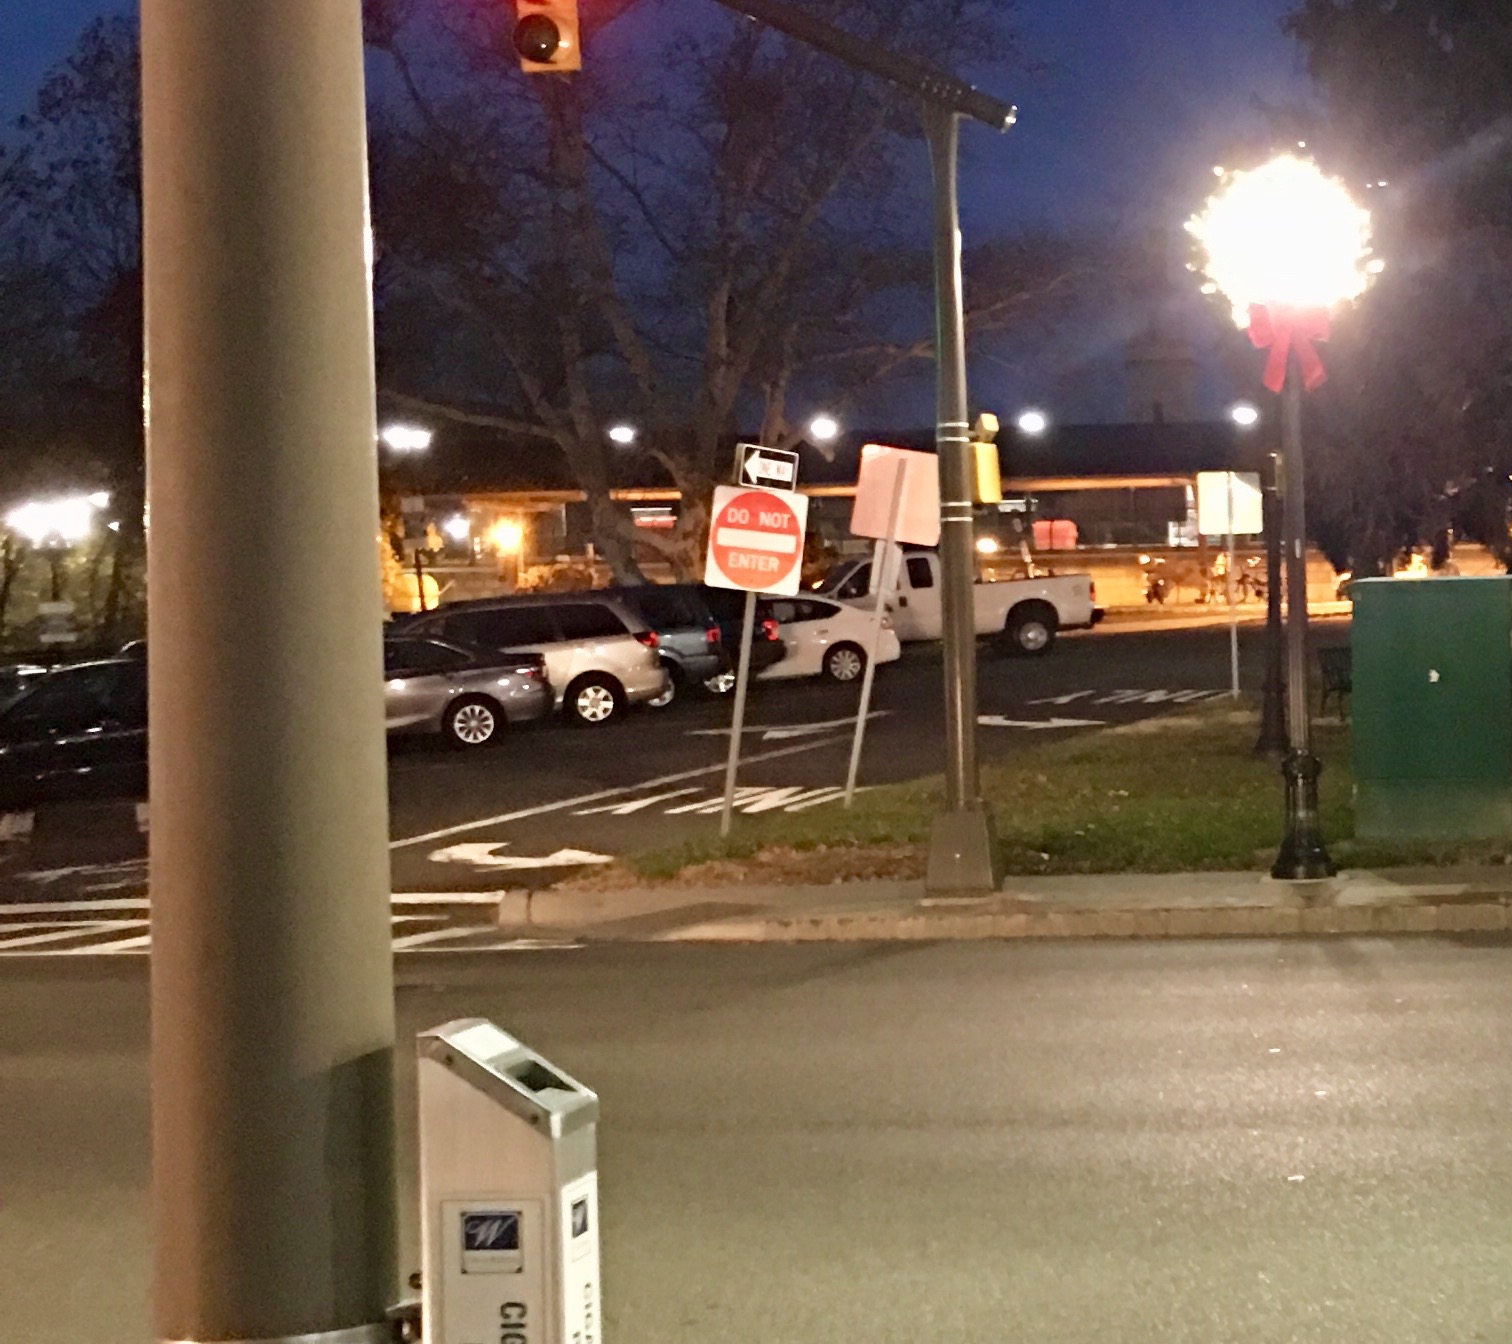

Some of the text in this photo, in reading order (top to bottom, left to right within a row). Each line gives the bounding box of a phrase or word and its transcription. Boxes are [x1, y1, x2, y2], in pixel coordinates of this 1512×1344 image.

[727, 507, 791, 529] DO NOT
[728, 552, 780, 572] ENTER
